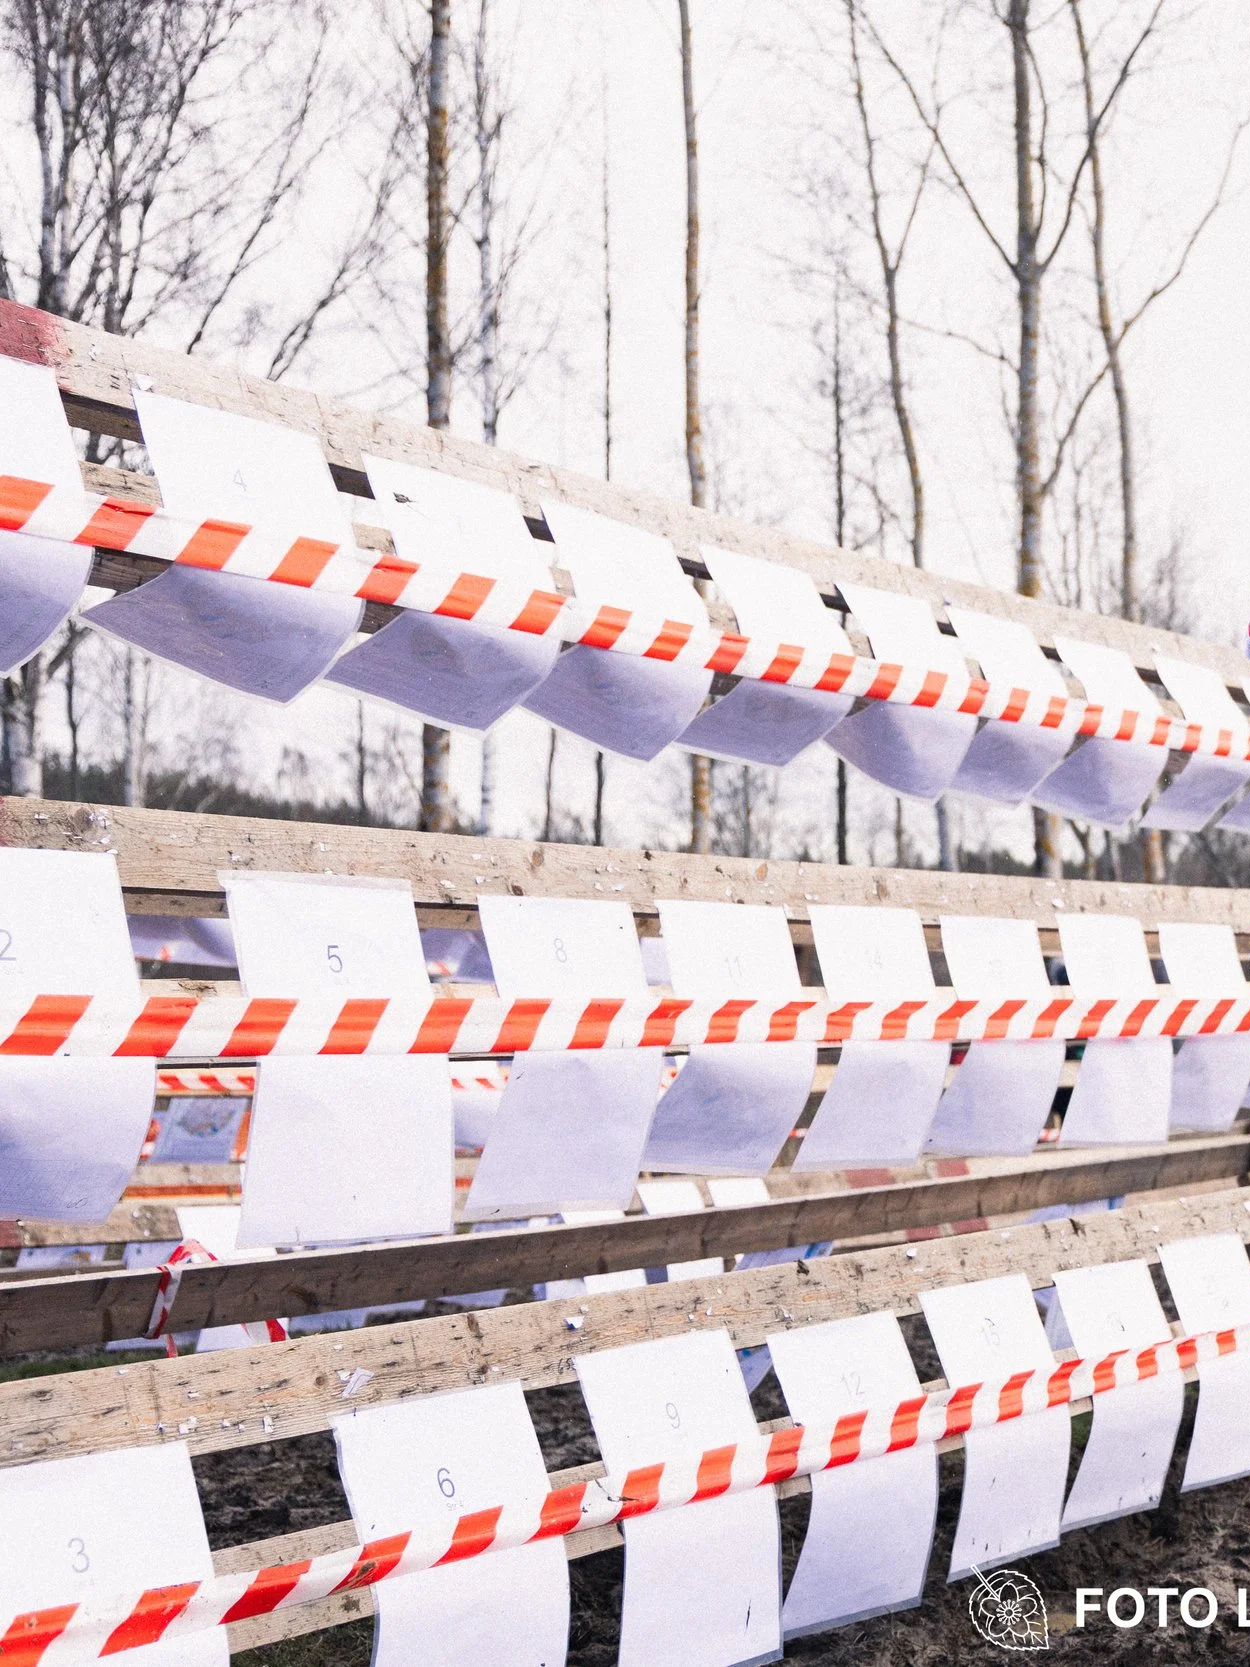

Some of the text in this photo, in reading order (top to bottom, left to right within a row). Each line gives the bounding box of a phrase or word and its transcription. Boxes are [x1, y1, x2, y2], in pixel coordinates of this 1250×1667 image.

[326, 944, 343, 973] 5
[553, 937, 568, 963] 8
[841, 1370, 865, 1397] 12
[665, 1401, 681, 1430] 9
[437, 1467, 455, 1498] 6
[67, 1536, 90, 1574] 3
